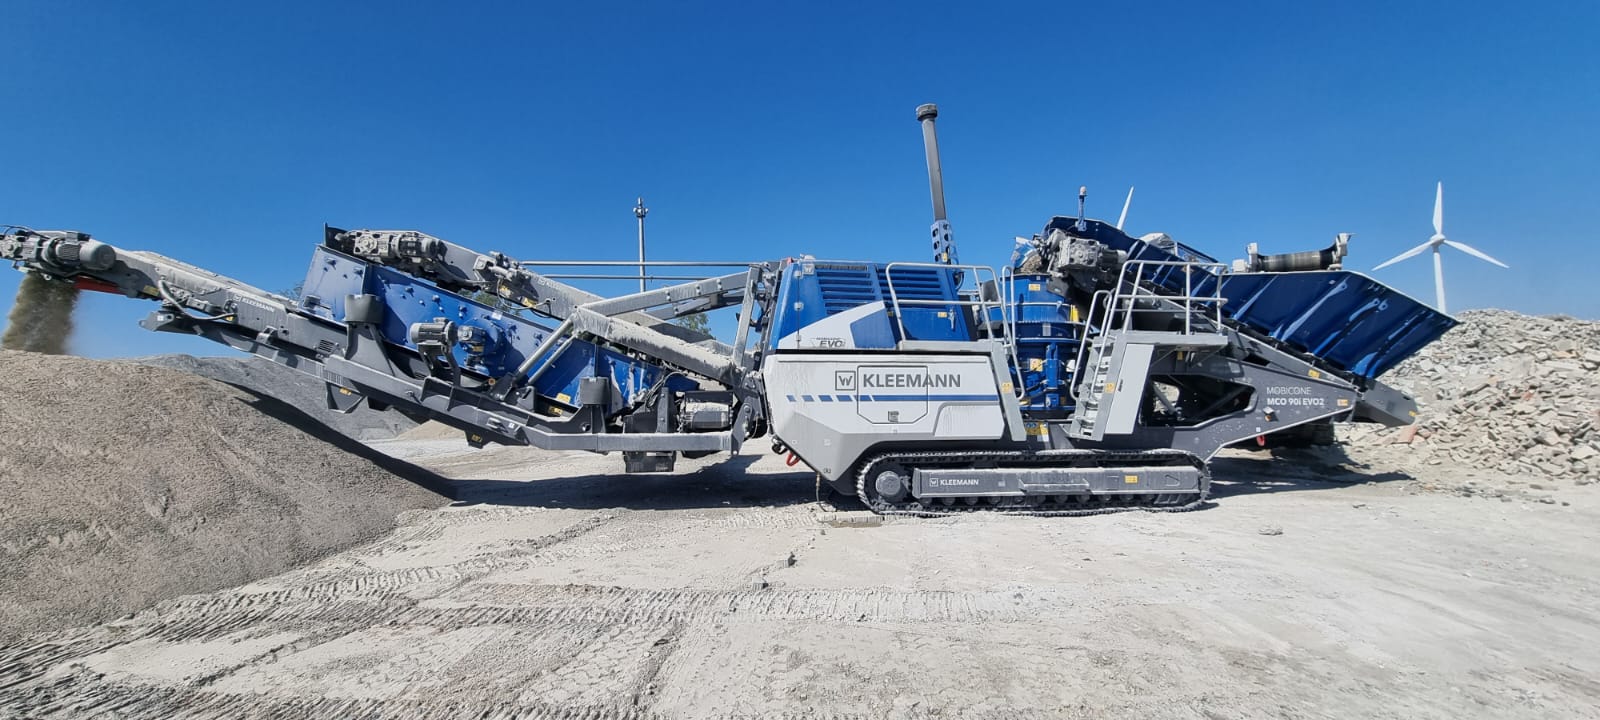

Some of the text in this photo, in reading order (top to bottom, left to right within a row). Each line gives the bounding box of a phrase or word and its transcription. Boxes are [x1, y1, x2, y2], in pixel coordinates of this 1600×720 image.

[863, 373, 961, 388] KLEEMANN
[1266, 386, 1312, 395] MOBICONE
[1267, 398, 1287, 406] MCO
[1302, 398, 1324, 406] EVO2
